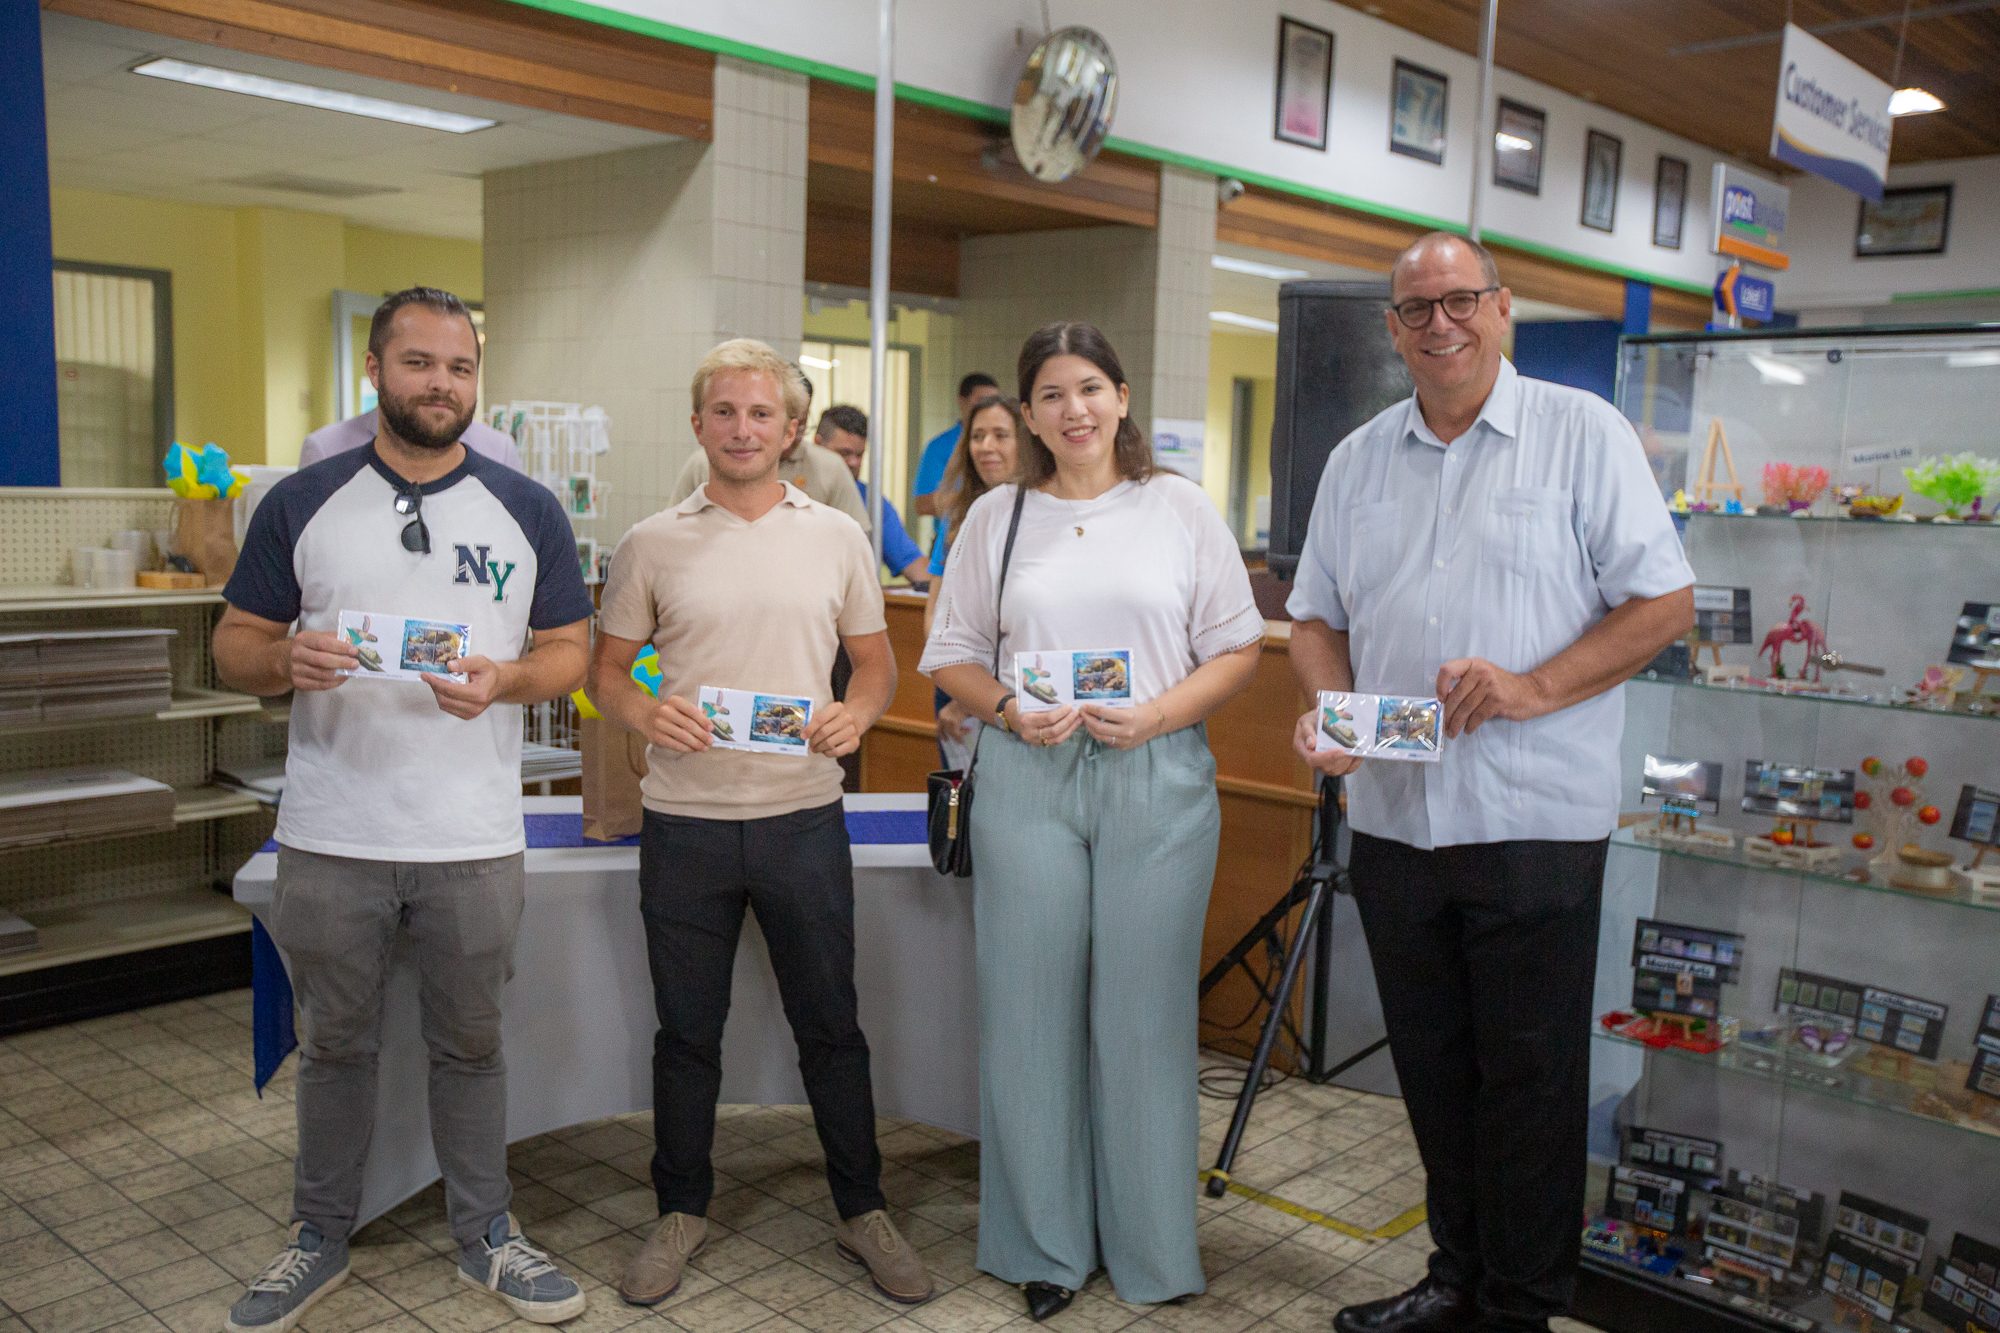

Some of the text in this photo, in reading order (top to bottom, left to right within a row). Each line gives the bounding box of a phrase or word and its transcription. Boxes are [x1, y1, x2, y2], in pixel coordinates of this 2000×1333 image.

[1784, 62, 1847, 128] Customer
[1894, 447, 1912, 459] Life
[453, 543, 516, 603] NY
